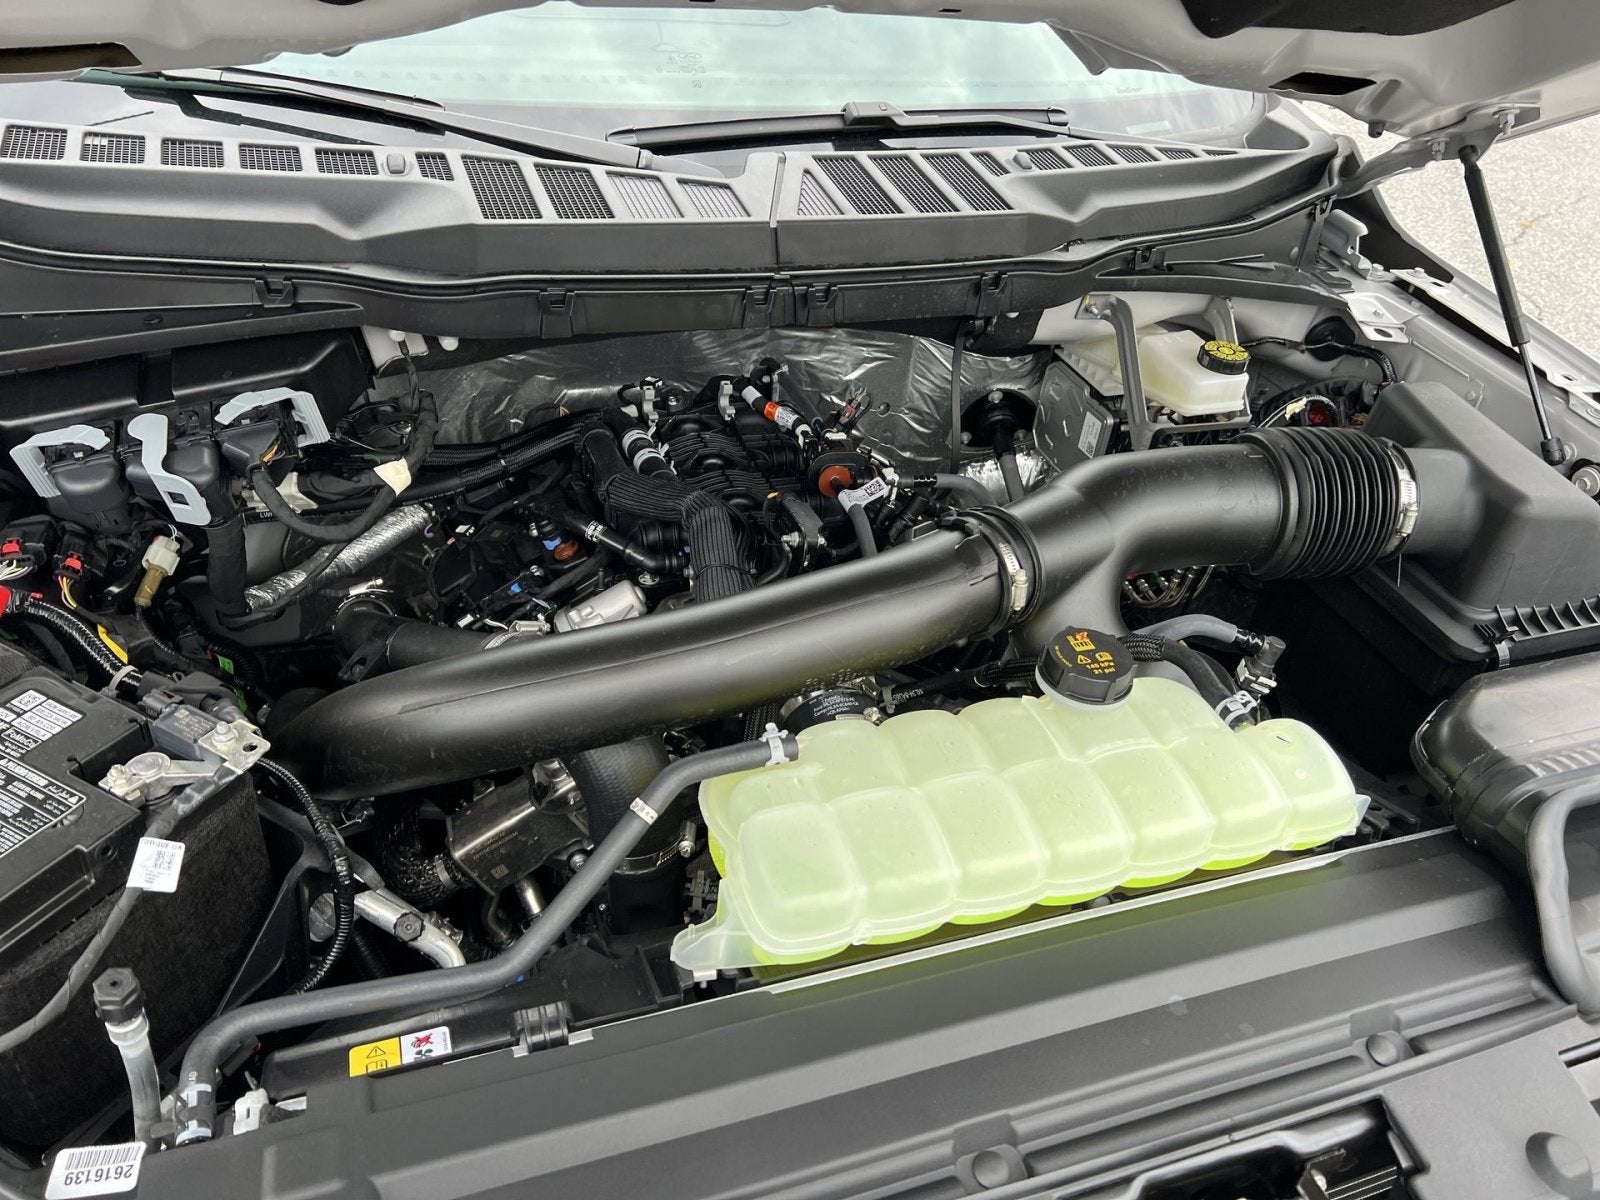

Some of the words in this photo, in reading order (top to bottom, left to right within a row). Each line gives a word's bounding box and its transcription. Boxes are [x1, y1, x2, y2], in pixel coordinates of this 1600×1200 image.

[1093, 667, 1102, 675] 21
[9, 729, 35, 747] FoMoCo
[64, 1164, 134, 1186] 2616139
